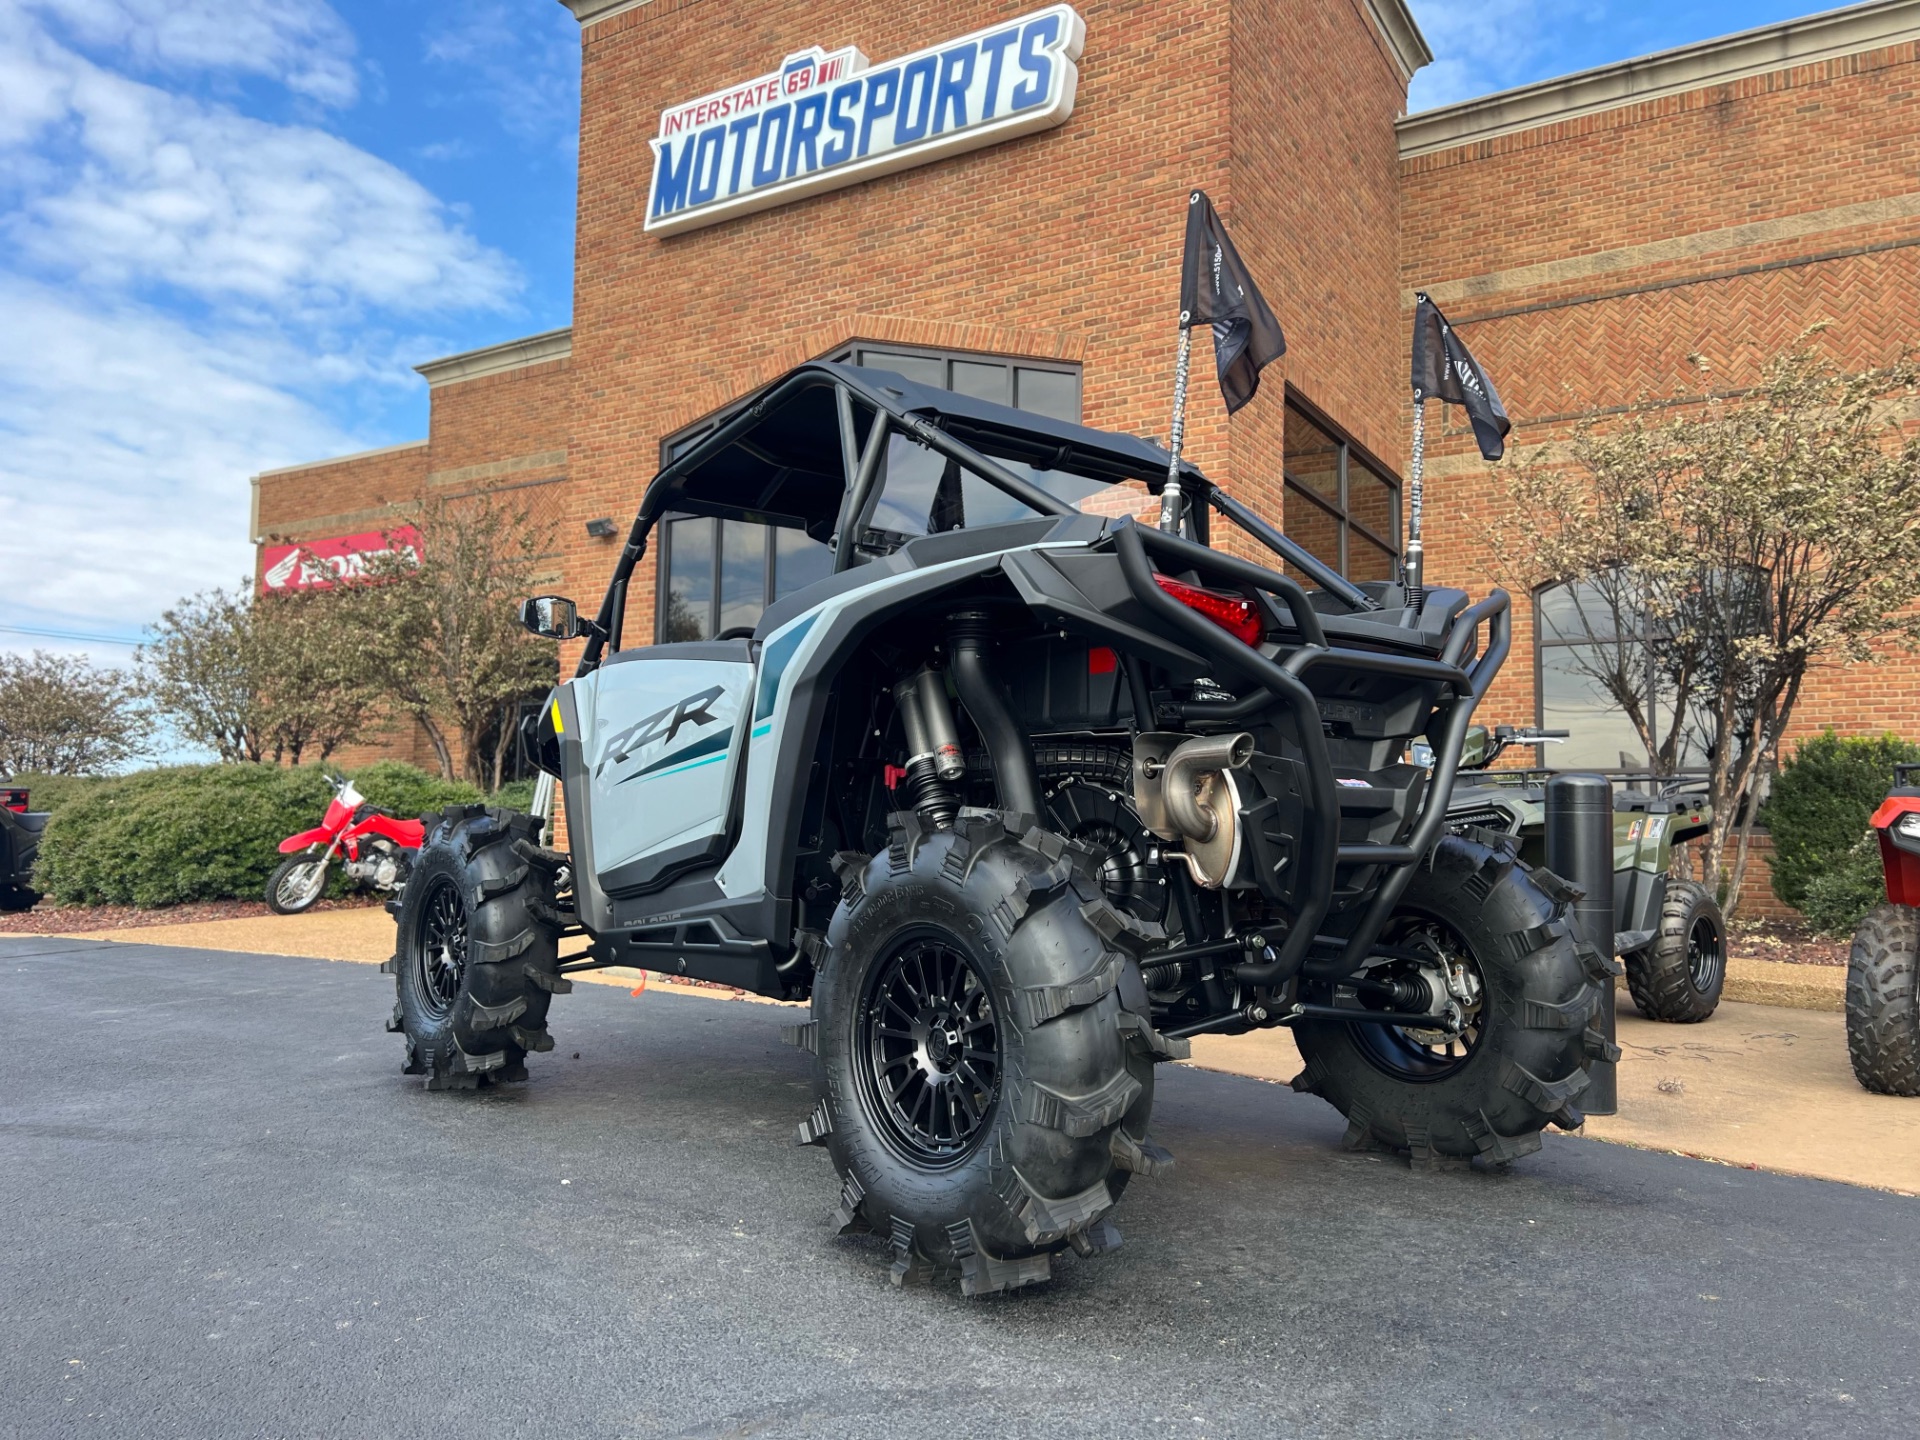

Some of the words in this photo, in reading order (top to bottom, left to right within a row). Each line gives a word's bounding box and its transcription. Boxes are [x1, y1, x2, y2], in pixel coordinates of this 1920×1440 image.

[651, 15, 1061, 218] MOTORSPORTS
[663, 78, 780, 136] INTERSTATE
[787, 68, 811, 94] 69
[594, 684, 726, 781] RZR
